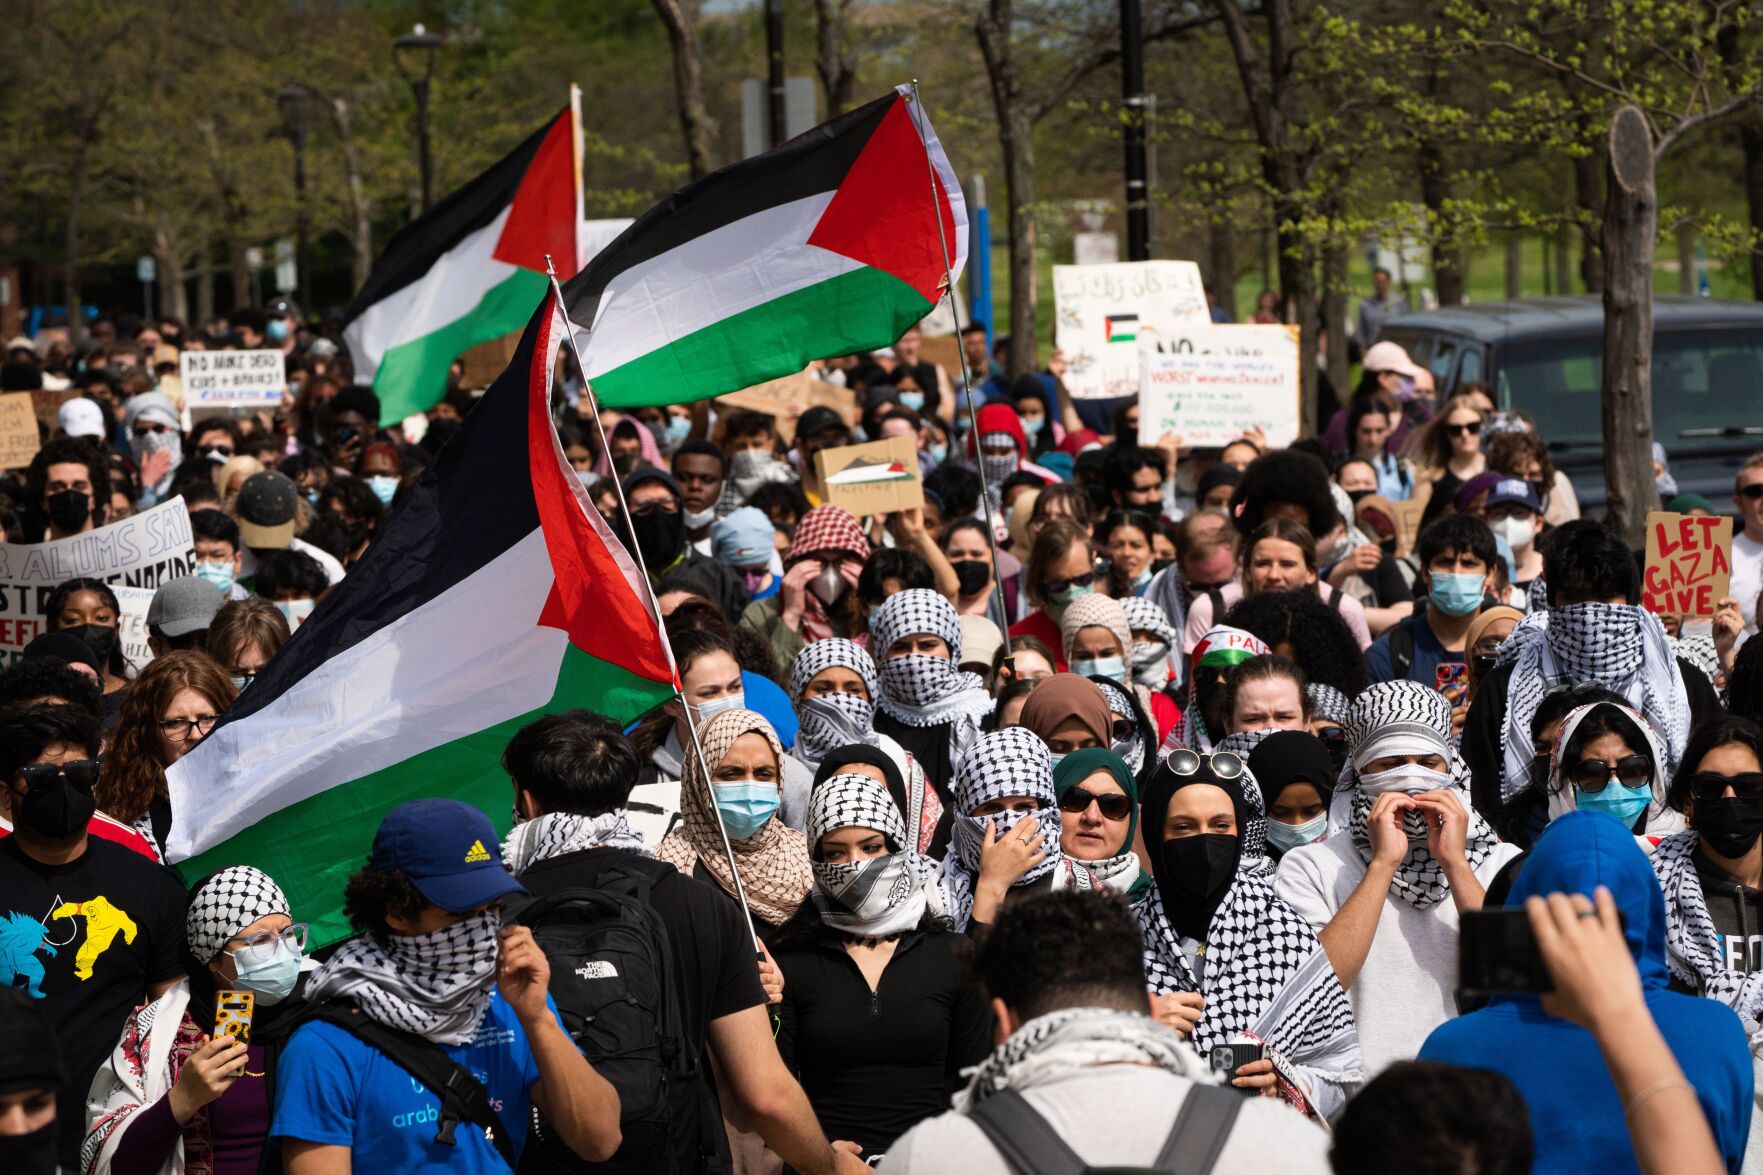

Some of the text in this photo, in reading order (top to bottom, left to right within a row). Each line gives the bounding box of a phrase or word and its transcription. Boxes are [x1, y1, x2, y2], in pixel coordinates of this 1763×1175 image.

[21, 523, 142, 581] ALUMS
[145, 502, 191, 558] SAY
[1656, 518, 1722, 558] LET
[1645, 544, 1728, 595] GAZA
[1643, 585, 1714, 615] LIVE
[464, 852, 491, 864] adidas
[575, 966, 605, 976] NORTH
[585, 960, 603, 969] THE
